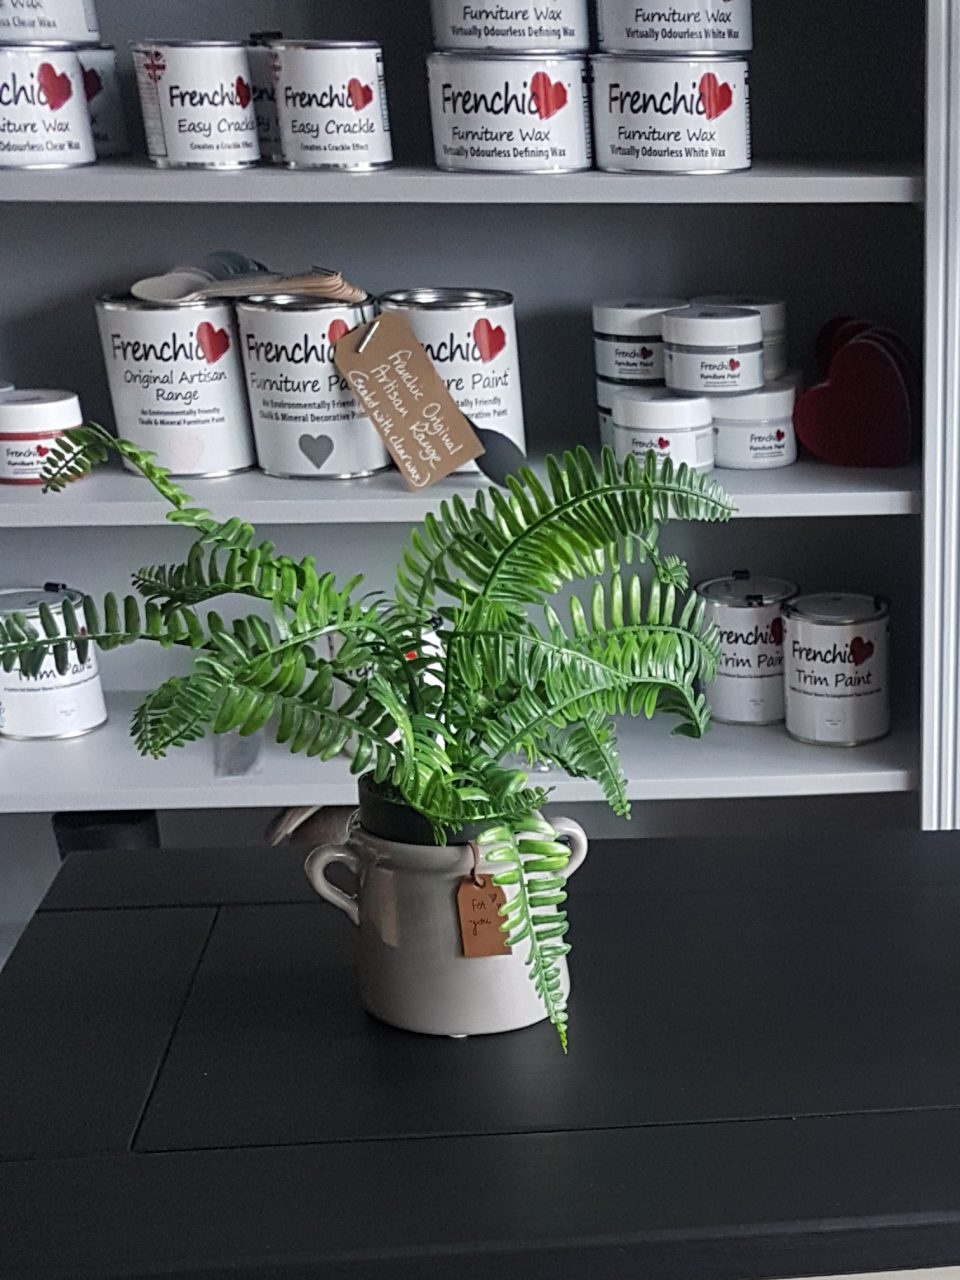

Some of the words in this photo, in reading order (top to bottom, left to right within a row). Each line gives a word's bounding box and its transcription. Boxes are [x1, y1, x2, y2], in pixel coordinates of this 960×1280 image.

[463, 5, 529, 21] Furniture
[534, 6, 562, 21] Wax
[635, 8, 701, 23] Furniture
[706, 9, 732, 23] Wax
[484, 26, 526, 38] Odourless
[528, 26, 561, 39] Defining
[661, 29, 702, 39] Odourless
[43, 120, 70, 132] Wax
[178, 118, 212, 138] Easy
[291, 119, 320, 139] Easy
[325, 118, 376, 134] Crackle
[452, 126, 515, 142] Furniture
[520, 128, 551, 142] Wax
[618, 126, 682, 142] Furniture
[687, 128, 716, 142] Wax
[470, 147, 511, 158] Odourless
[513, 147, 549, 160] Defining
[641, 146, 683, 158] Odourless
[684, 147, 709, 158] White
[124, 369, 173, 388] Original
[178, 368, 228, 384] Artisan
[250, 373, 320, 392] Furniture
[472, 368, 510, 390] Paint
[156, 388, 199, 405] Range
[370, 364, 409, 418] Artisan
[475, 396, 501, 409] Friendly
[757, 651, 784, 668] Pain
[796, 669, 829, 686] Trim
[835, 670, 872, 688] Paint
